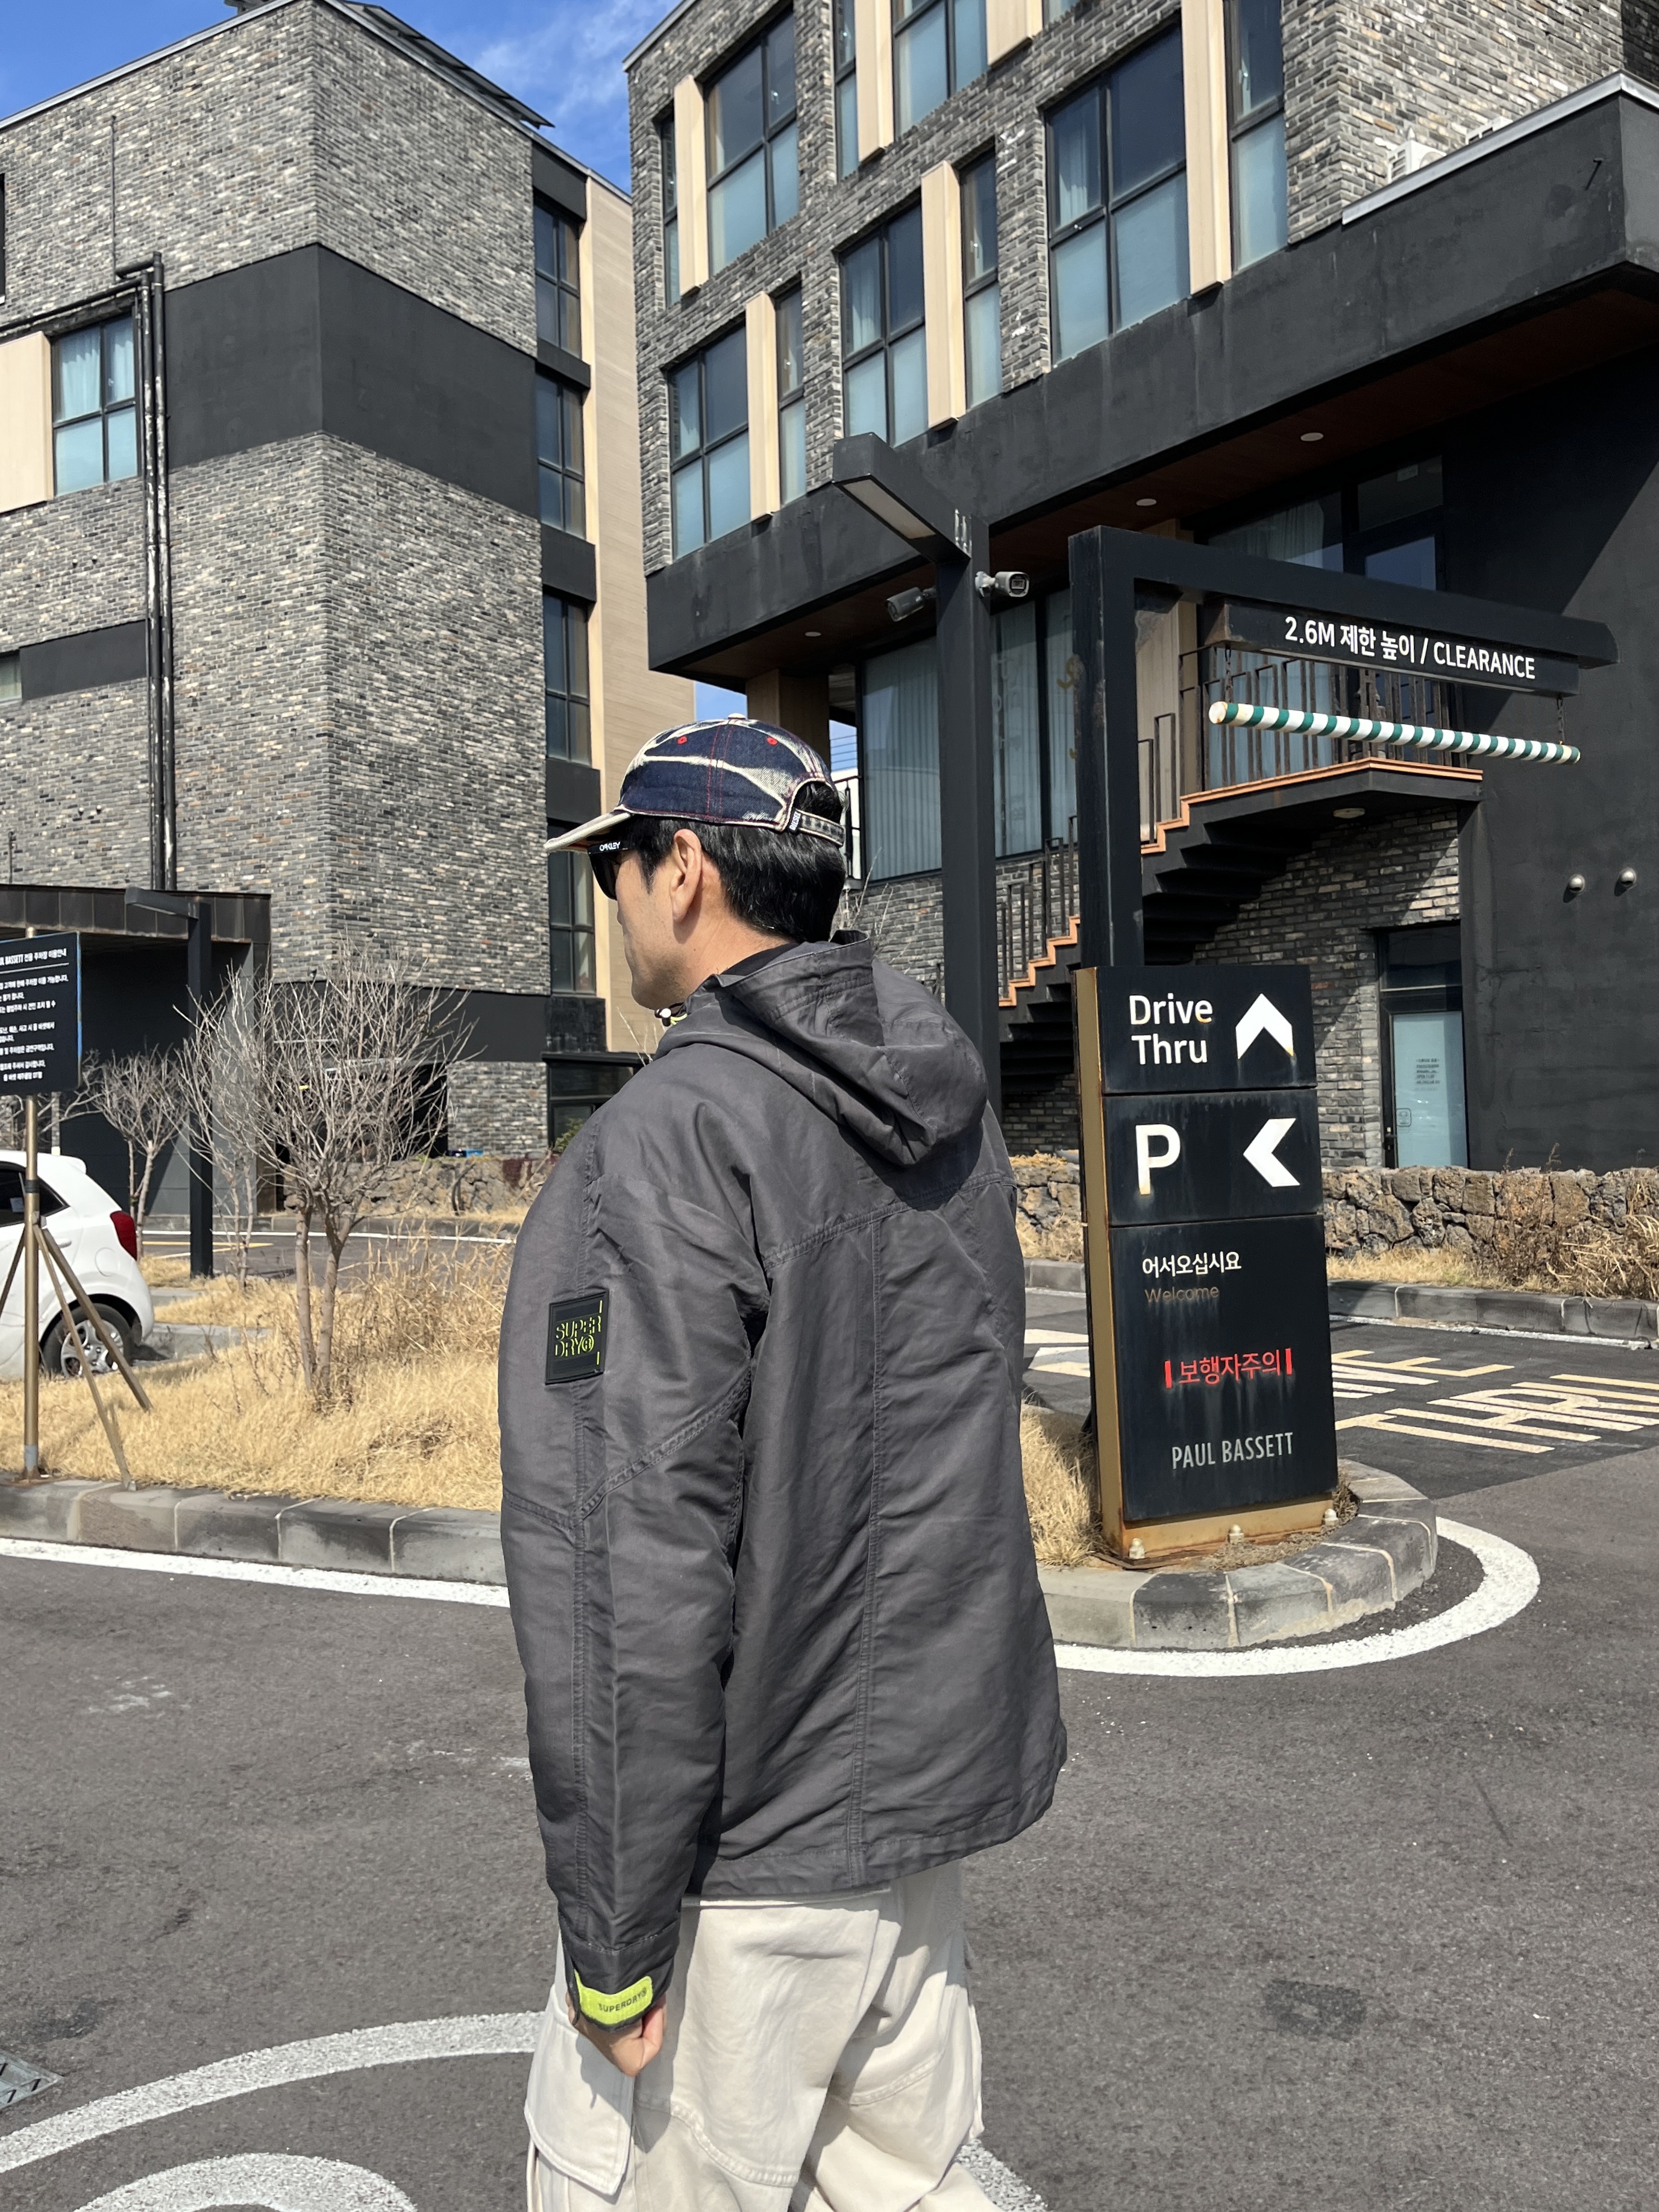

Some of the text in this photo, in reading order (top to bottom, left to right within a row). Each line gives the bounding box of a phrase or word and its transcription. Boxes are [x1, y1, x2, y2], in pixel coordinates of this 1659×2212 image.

[1285, 616, 1536, 679] 2.6M 제한 높이 / CLEARANCE
[789, 810, 801, 831] DIESEL
[599, 841, 621, 851] OAKLEY
[1129, 992, 1213, 1025] Drive
[1131, 1033, 1208, 1065] Thru
[1135, 1124, 1181, 1195] P
[1142, 1251, 1242, 1279] 어서오십시요
[1144, 1285, 1220, 1303] Welcome
[1178, 1349, 1281, 1385] 보행자주의
[1172, 1432, 1293, 1470] PAUL BASSETT
